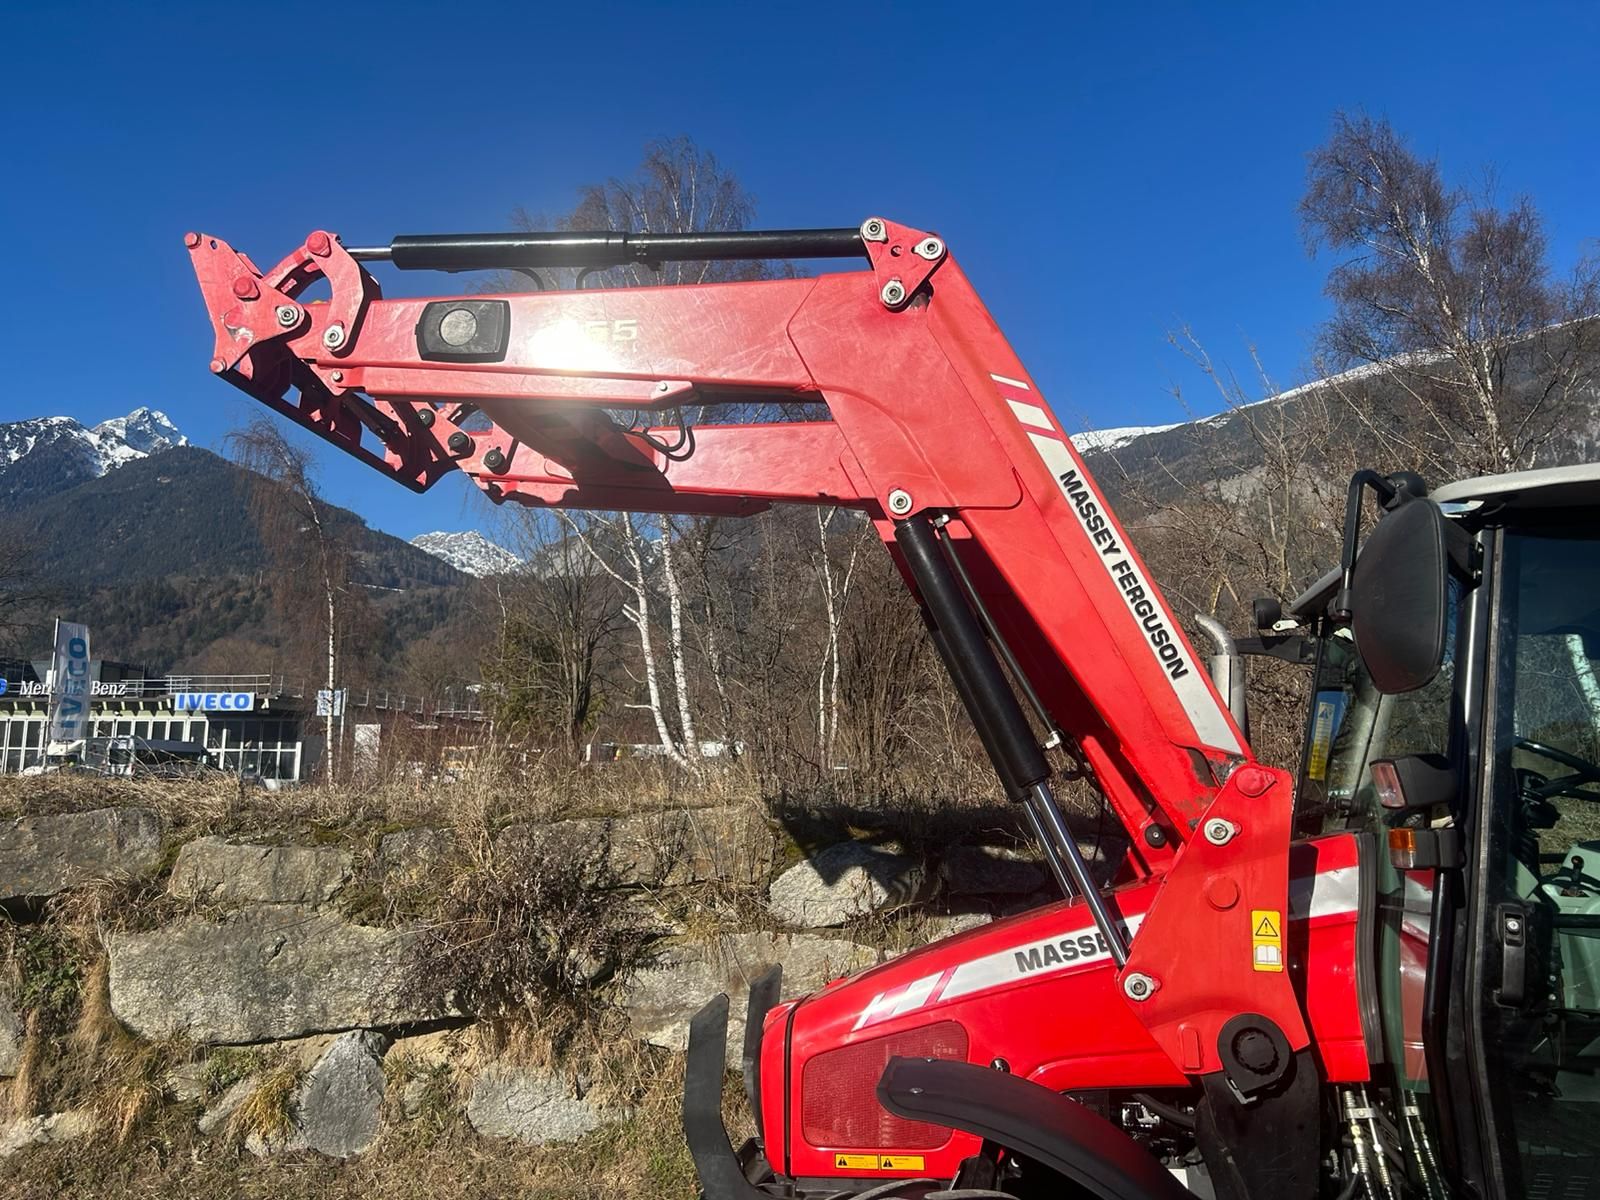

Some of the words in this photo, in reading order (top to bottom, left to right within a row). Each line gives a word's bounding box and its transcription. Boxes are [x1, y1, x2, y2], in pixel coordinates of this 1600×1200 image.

[1059, 469, 1121, 557] MASSEY
[1112, 559, 1189, 681] FERGUSON
[177, 693, 250, 709] IVECO
[1014, 932, 1109, 973] MASSE
